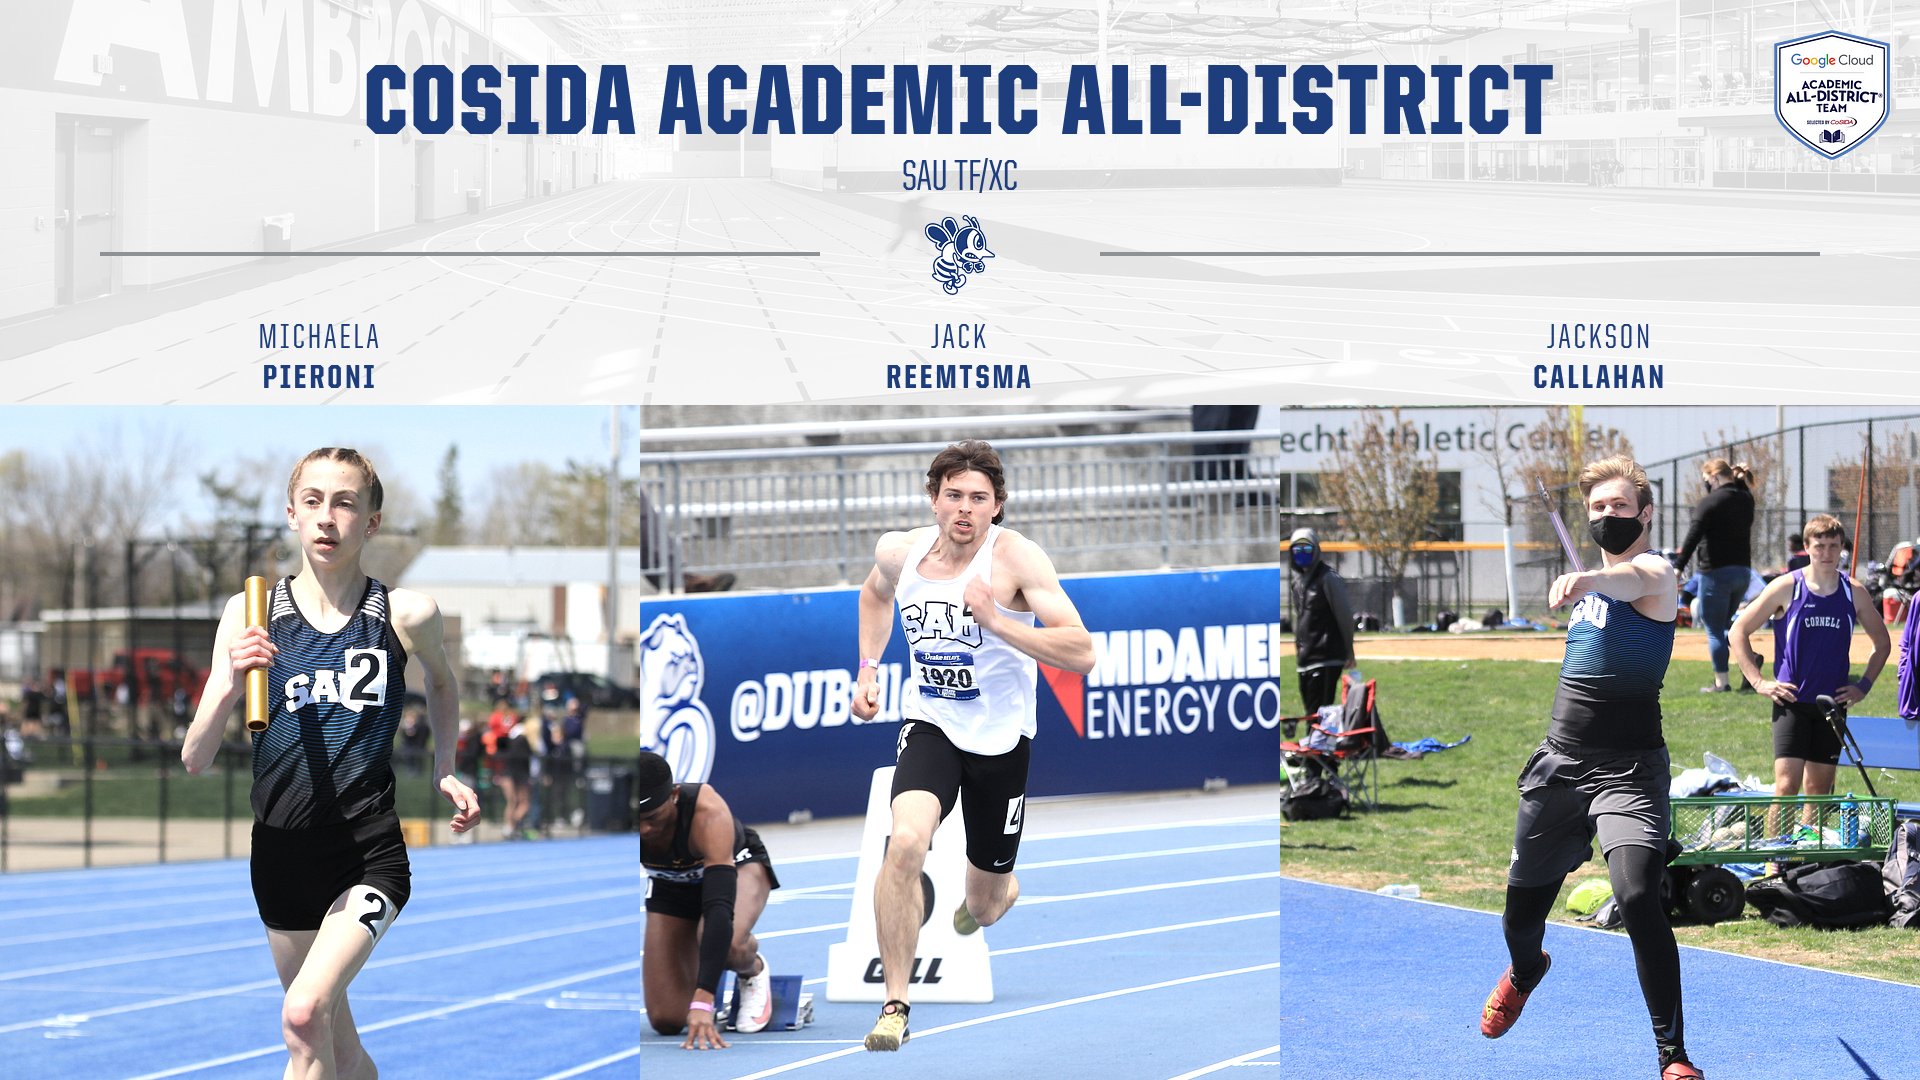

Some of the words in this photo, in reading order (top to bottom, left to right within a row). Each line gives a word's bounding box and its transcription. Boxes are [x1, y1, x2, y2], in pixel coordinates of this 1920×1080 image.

[1506, 423, 1618, 451] Cener
[1804, 616, 1841, 629] CORNELL
[349, 652, 380, 702] 2
[920, 666, 973, 689] 1920
[1087, 684, 1222, 740] ENERGY
[1227, 681, 1280, 731] CO
[359, 892, 387, 940] 2
[863, 957, 943, 984] GLL
